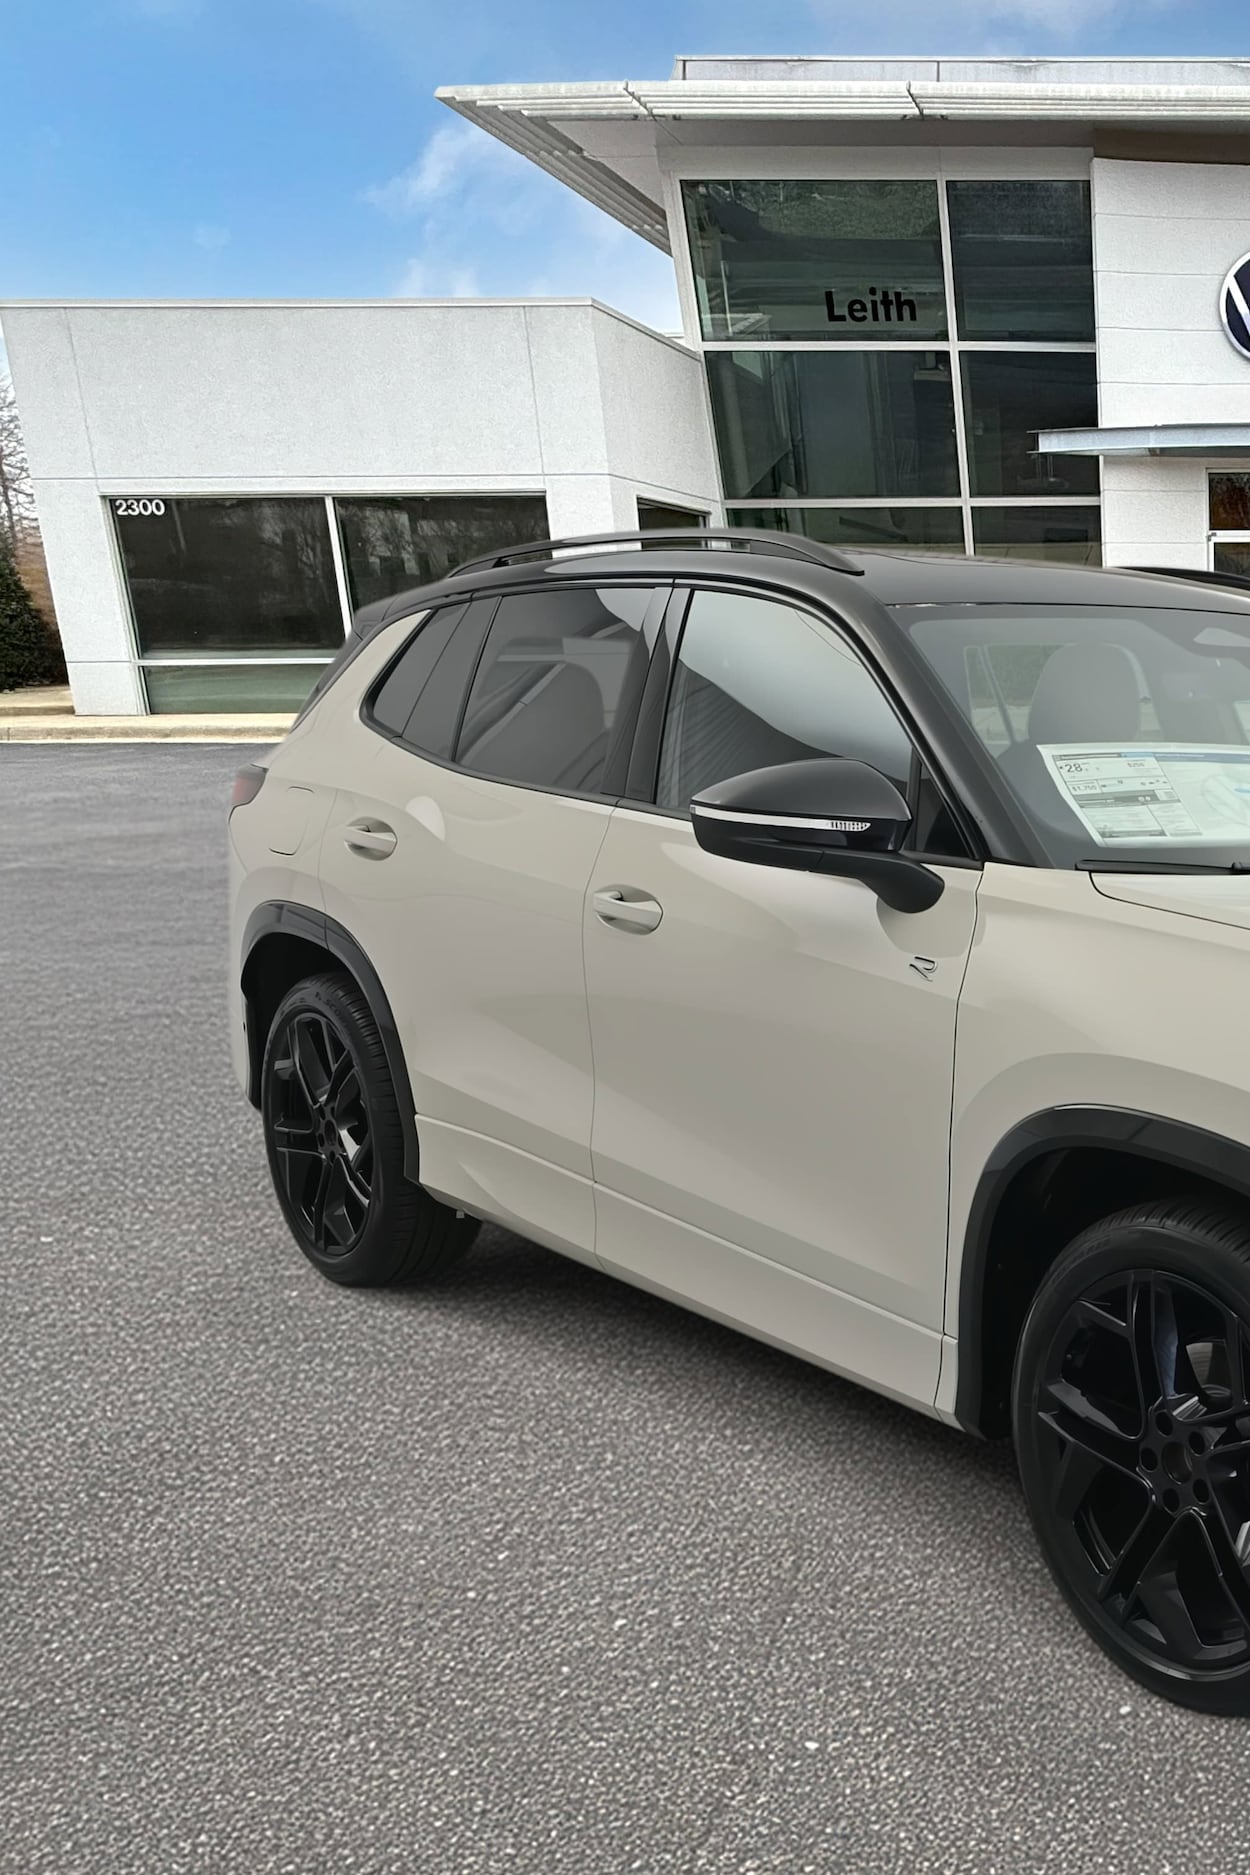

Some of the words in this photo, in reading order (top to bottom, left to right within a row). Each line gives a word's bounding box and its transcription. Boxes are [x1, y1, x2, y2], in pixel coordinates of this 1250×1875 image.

[825, 286, 917, 322] Leith
[115, 499, 165, 516] 2300
[1064, 763, 1083, 773] 28
